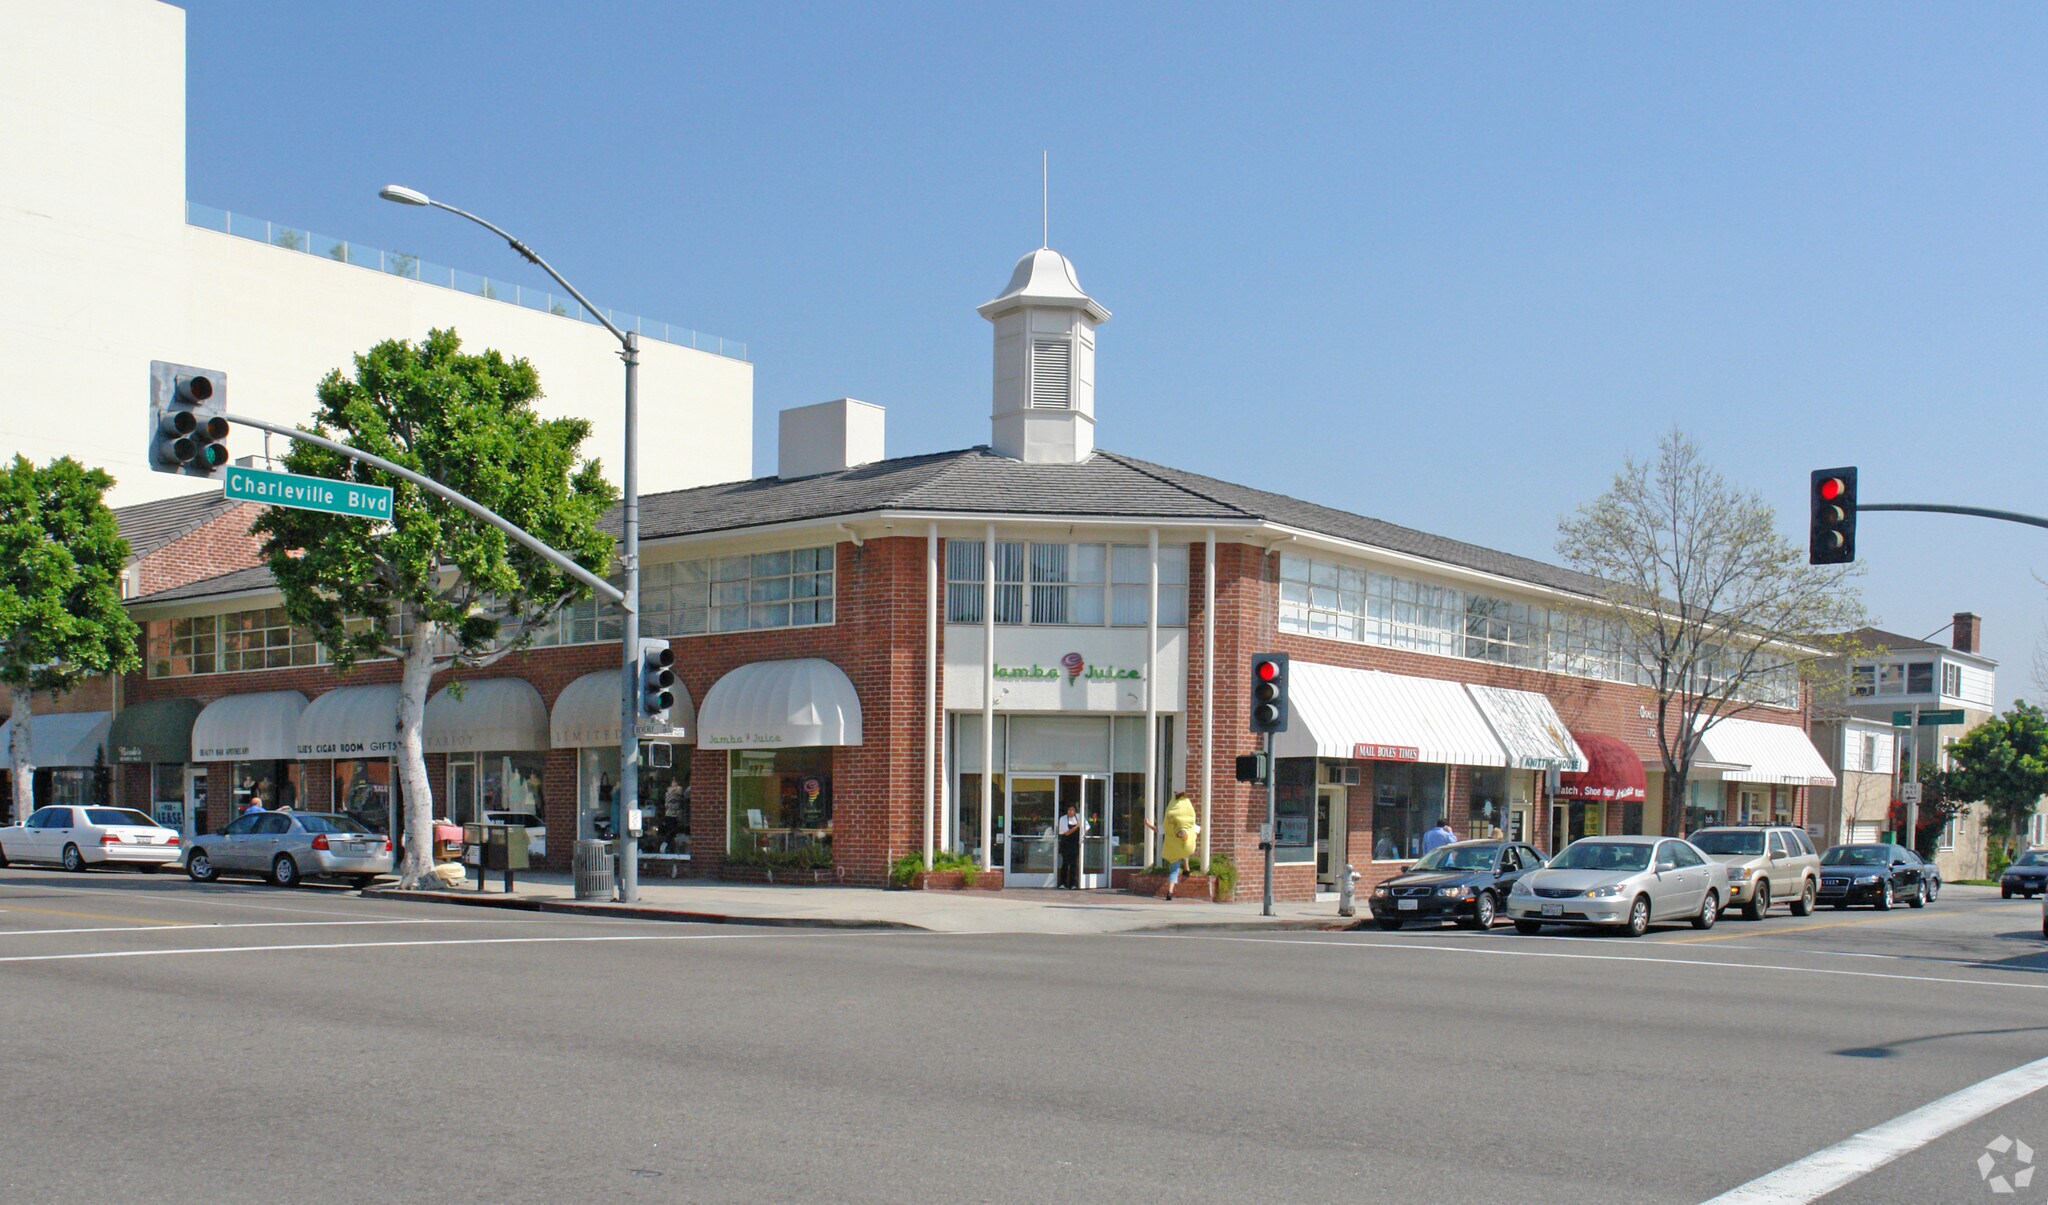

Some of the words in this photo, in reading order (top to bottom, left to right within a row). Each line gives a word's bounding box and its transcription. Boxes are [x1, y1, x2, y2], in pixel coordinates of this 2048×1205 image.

[230, 474, 333, 504] Charleville
[348, 491, 387, 512] Blvd
[1085, 664, 1141, 679] Juice
[709, 735, 743, 744] Jamba
[752, 733, 782, 743] Juice
[316, 743, 336, 753] CIGAR
[340, 742, 364, 753] ROOM
[1359, 745, 1375, 757] MAIL
[1377, 746, 1396, 758] BOXES
[1398, 748, 1417, 759] TIMES
[1560, 786, 1578, 795] atch
[1584, 786, 1601, 796] Shoe
[157, 811, 182, 824] LEASE
